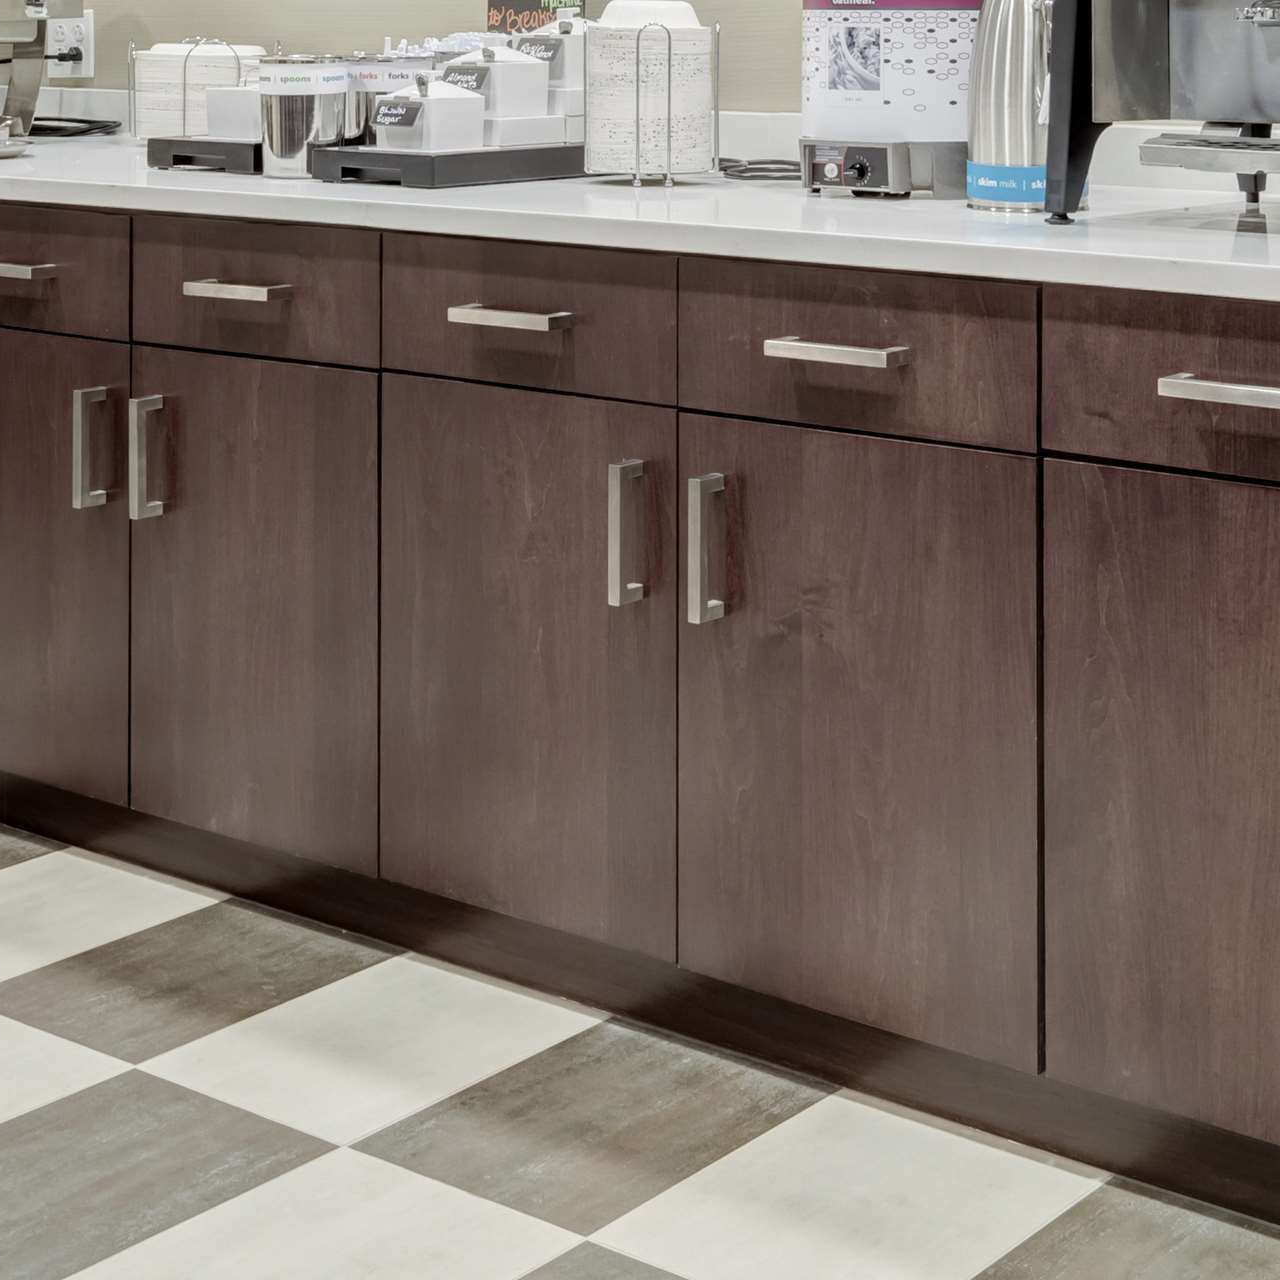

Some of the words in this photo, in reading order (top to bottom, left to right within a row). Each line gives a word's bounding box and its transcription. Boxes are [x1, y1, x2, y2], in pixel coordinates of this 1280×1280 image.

[280, 75, 312, 84] spoons
[359, 72, 378, 80] forks
[388, 72, 409, 80] forks
[376, 114, 403, 125] Sugar
[978, 177, 998, 187] skim
[998, 178, 1018, 189] milk
